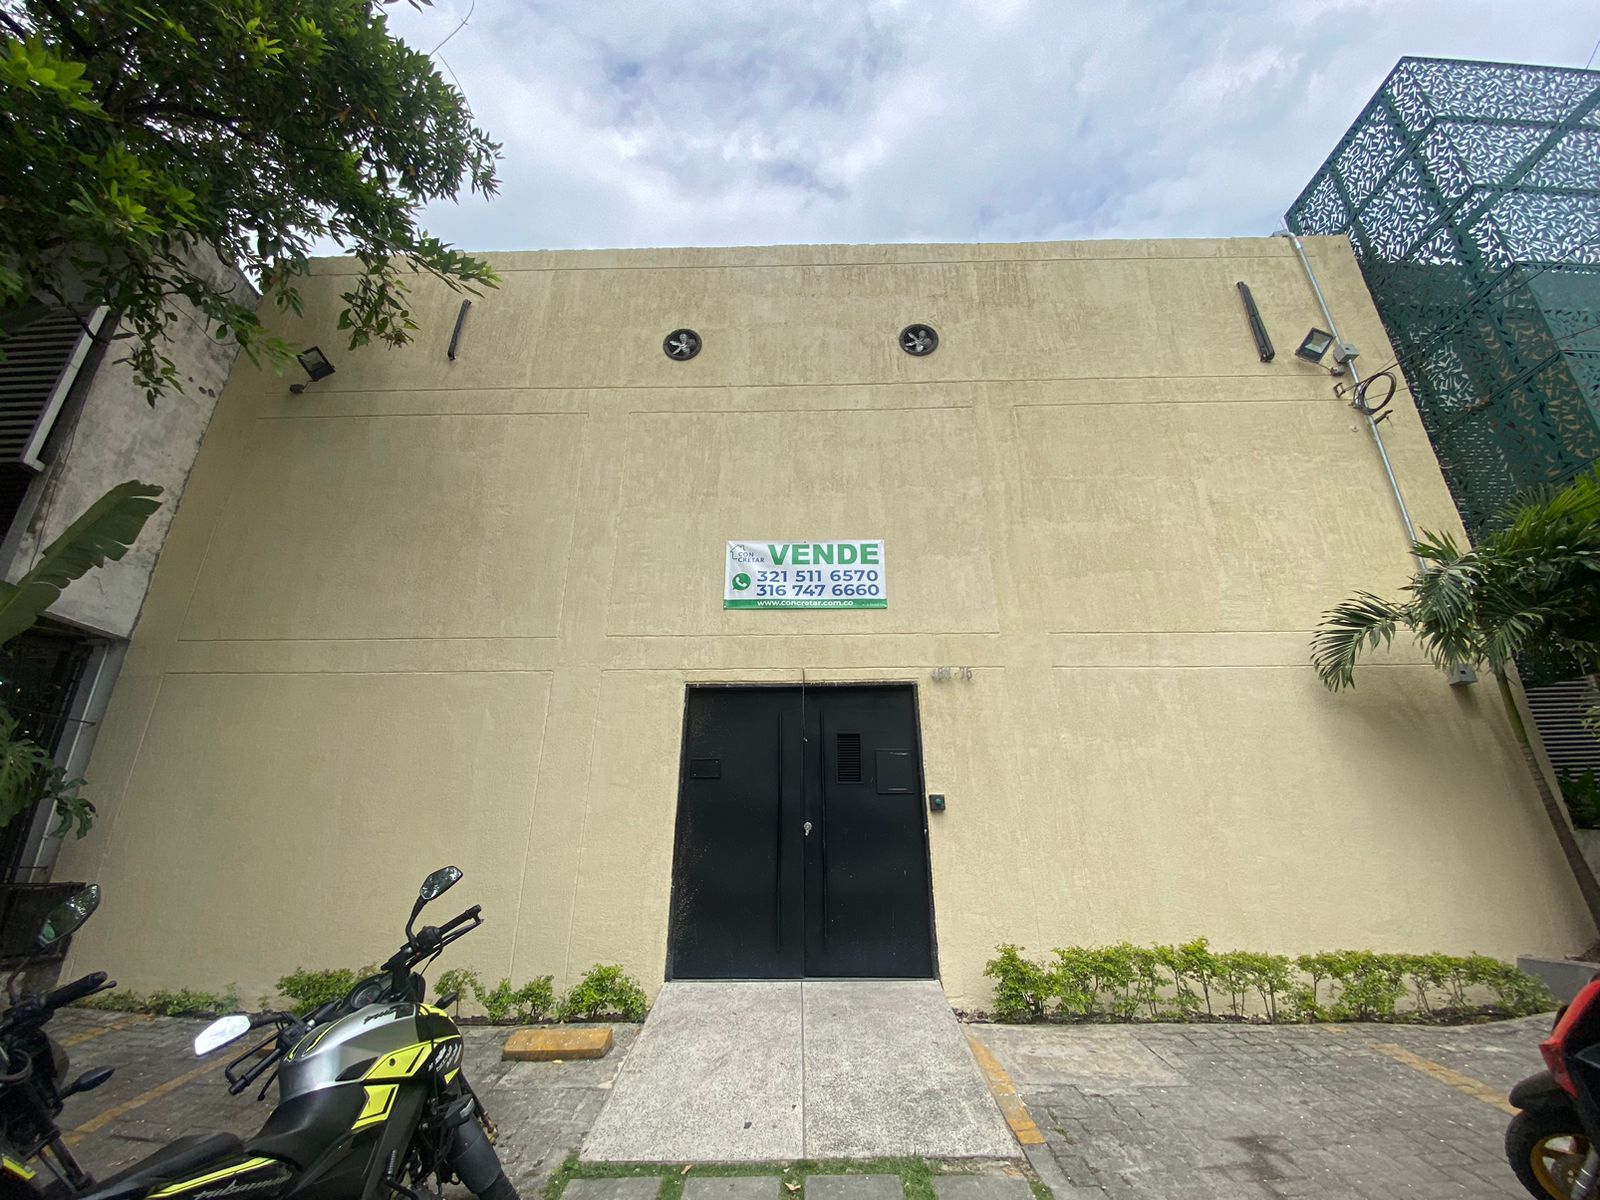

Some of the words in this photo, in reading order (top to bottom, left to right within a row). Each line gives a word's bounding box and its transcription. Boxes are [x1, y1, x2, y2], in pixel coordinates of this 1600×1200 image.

[767, 544, 879, 565] VENDE
[756, 570, 788, 583] 321
[795, 570, 822, 583] 511
[829, 569, 879, 582] 6570
[756, 584, 787, 597] 316
[792, 584, 826, 597] 747
[831, 584, 880, 597] 6660
